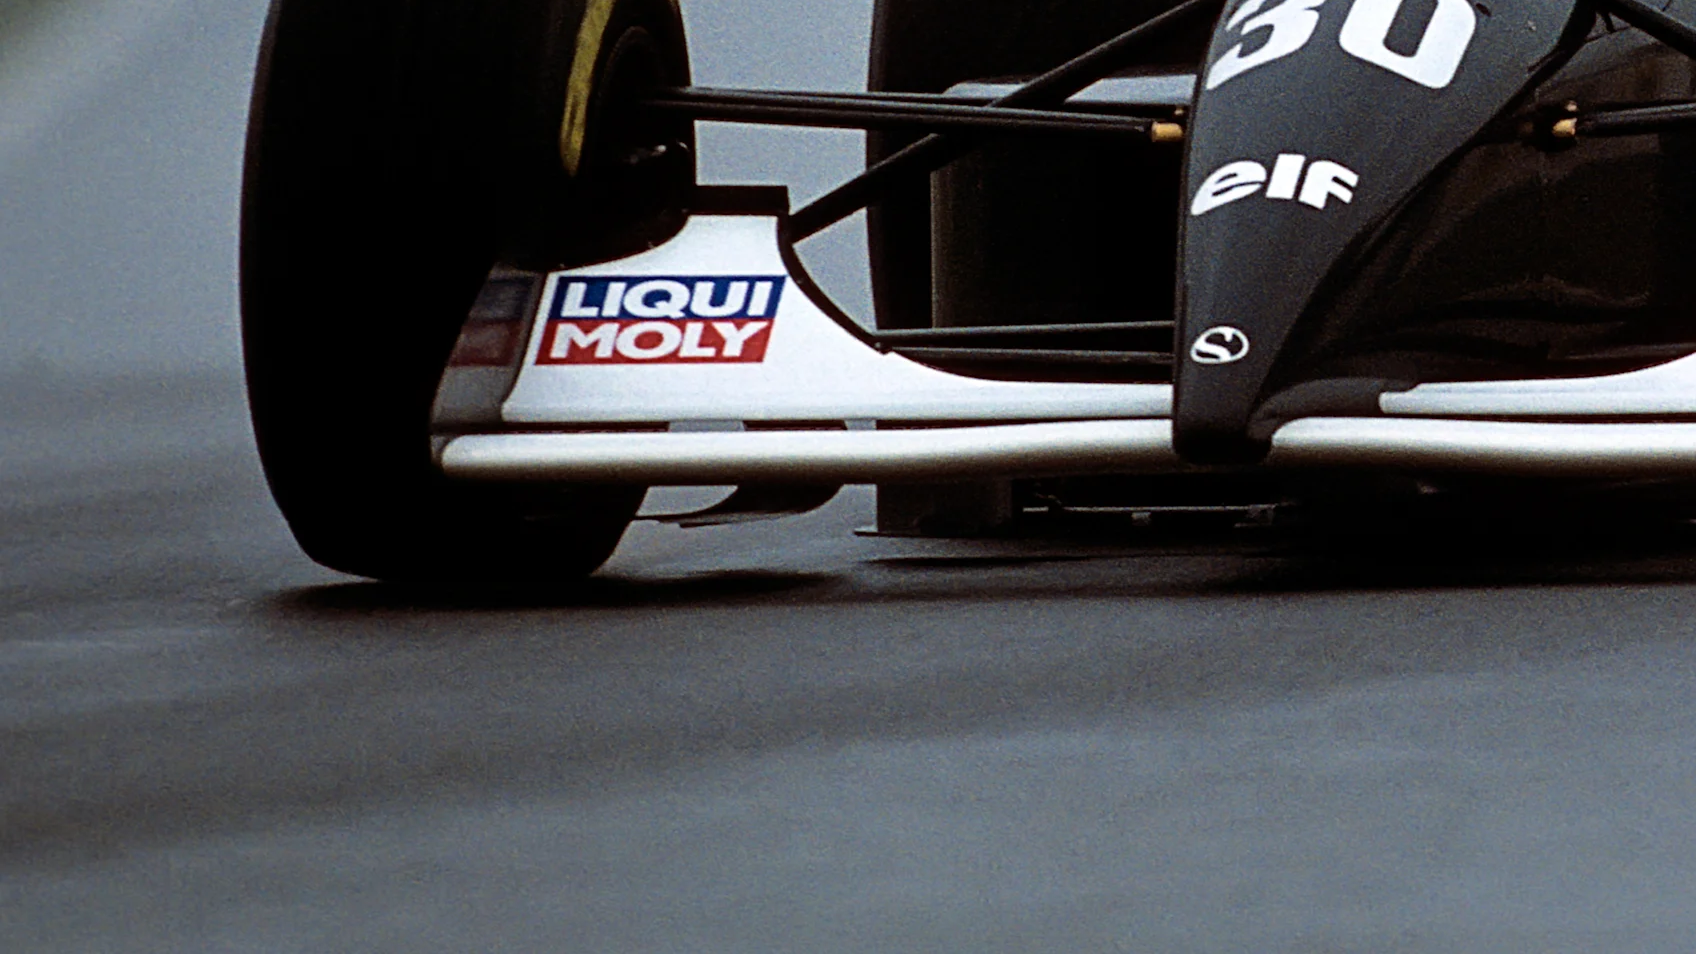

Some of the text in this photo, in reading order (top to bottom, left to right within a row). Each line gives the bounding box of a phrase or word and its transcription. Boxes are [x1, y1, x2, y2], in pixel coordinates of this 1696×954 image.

[1190, 153, 1360, 216] elf
[560, 279, 774, 319] LIQUI
[550, 320, 770, 360] MOLY
